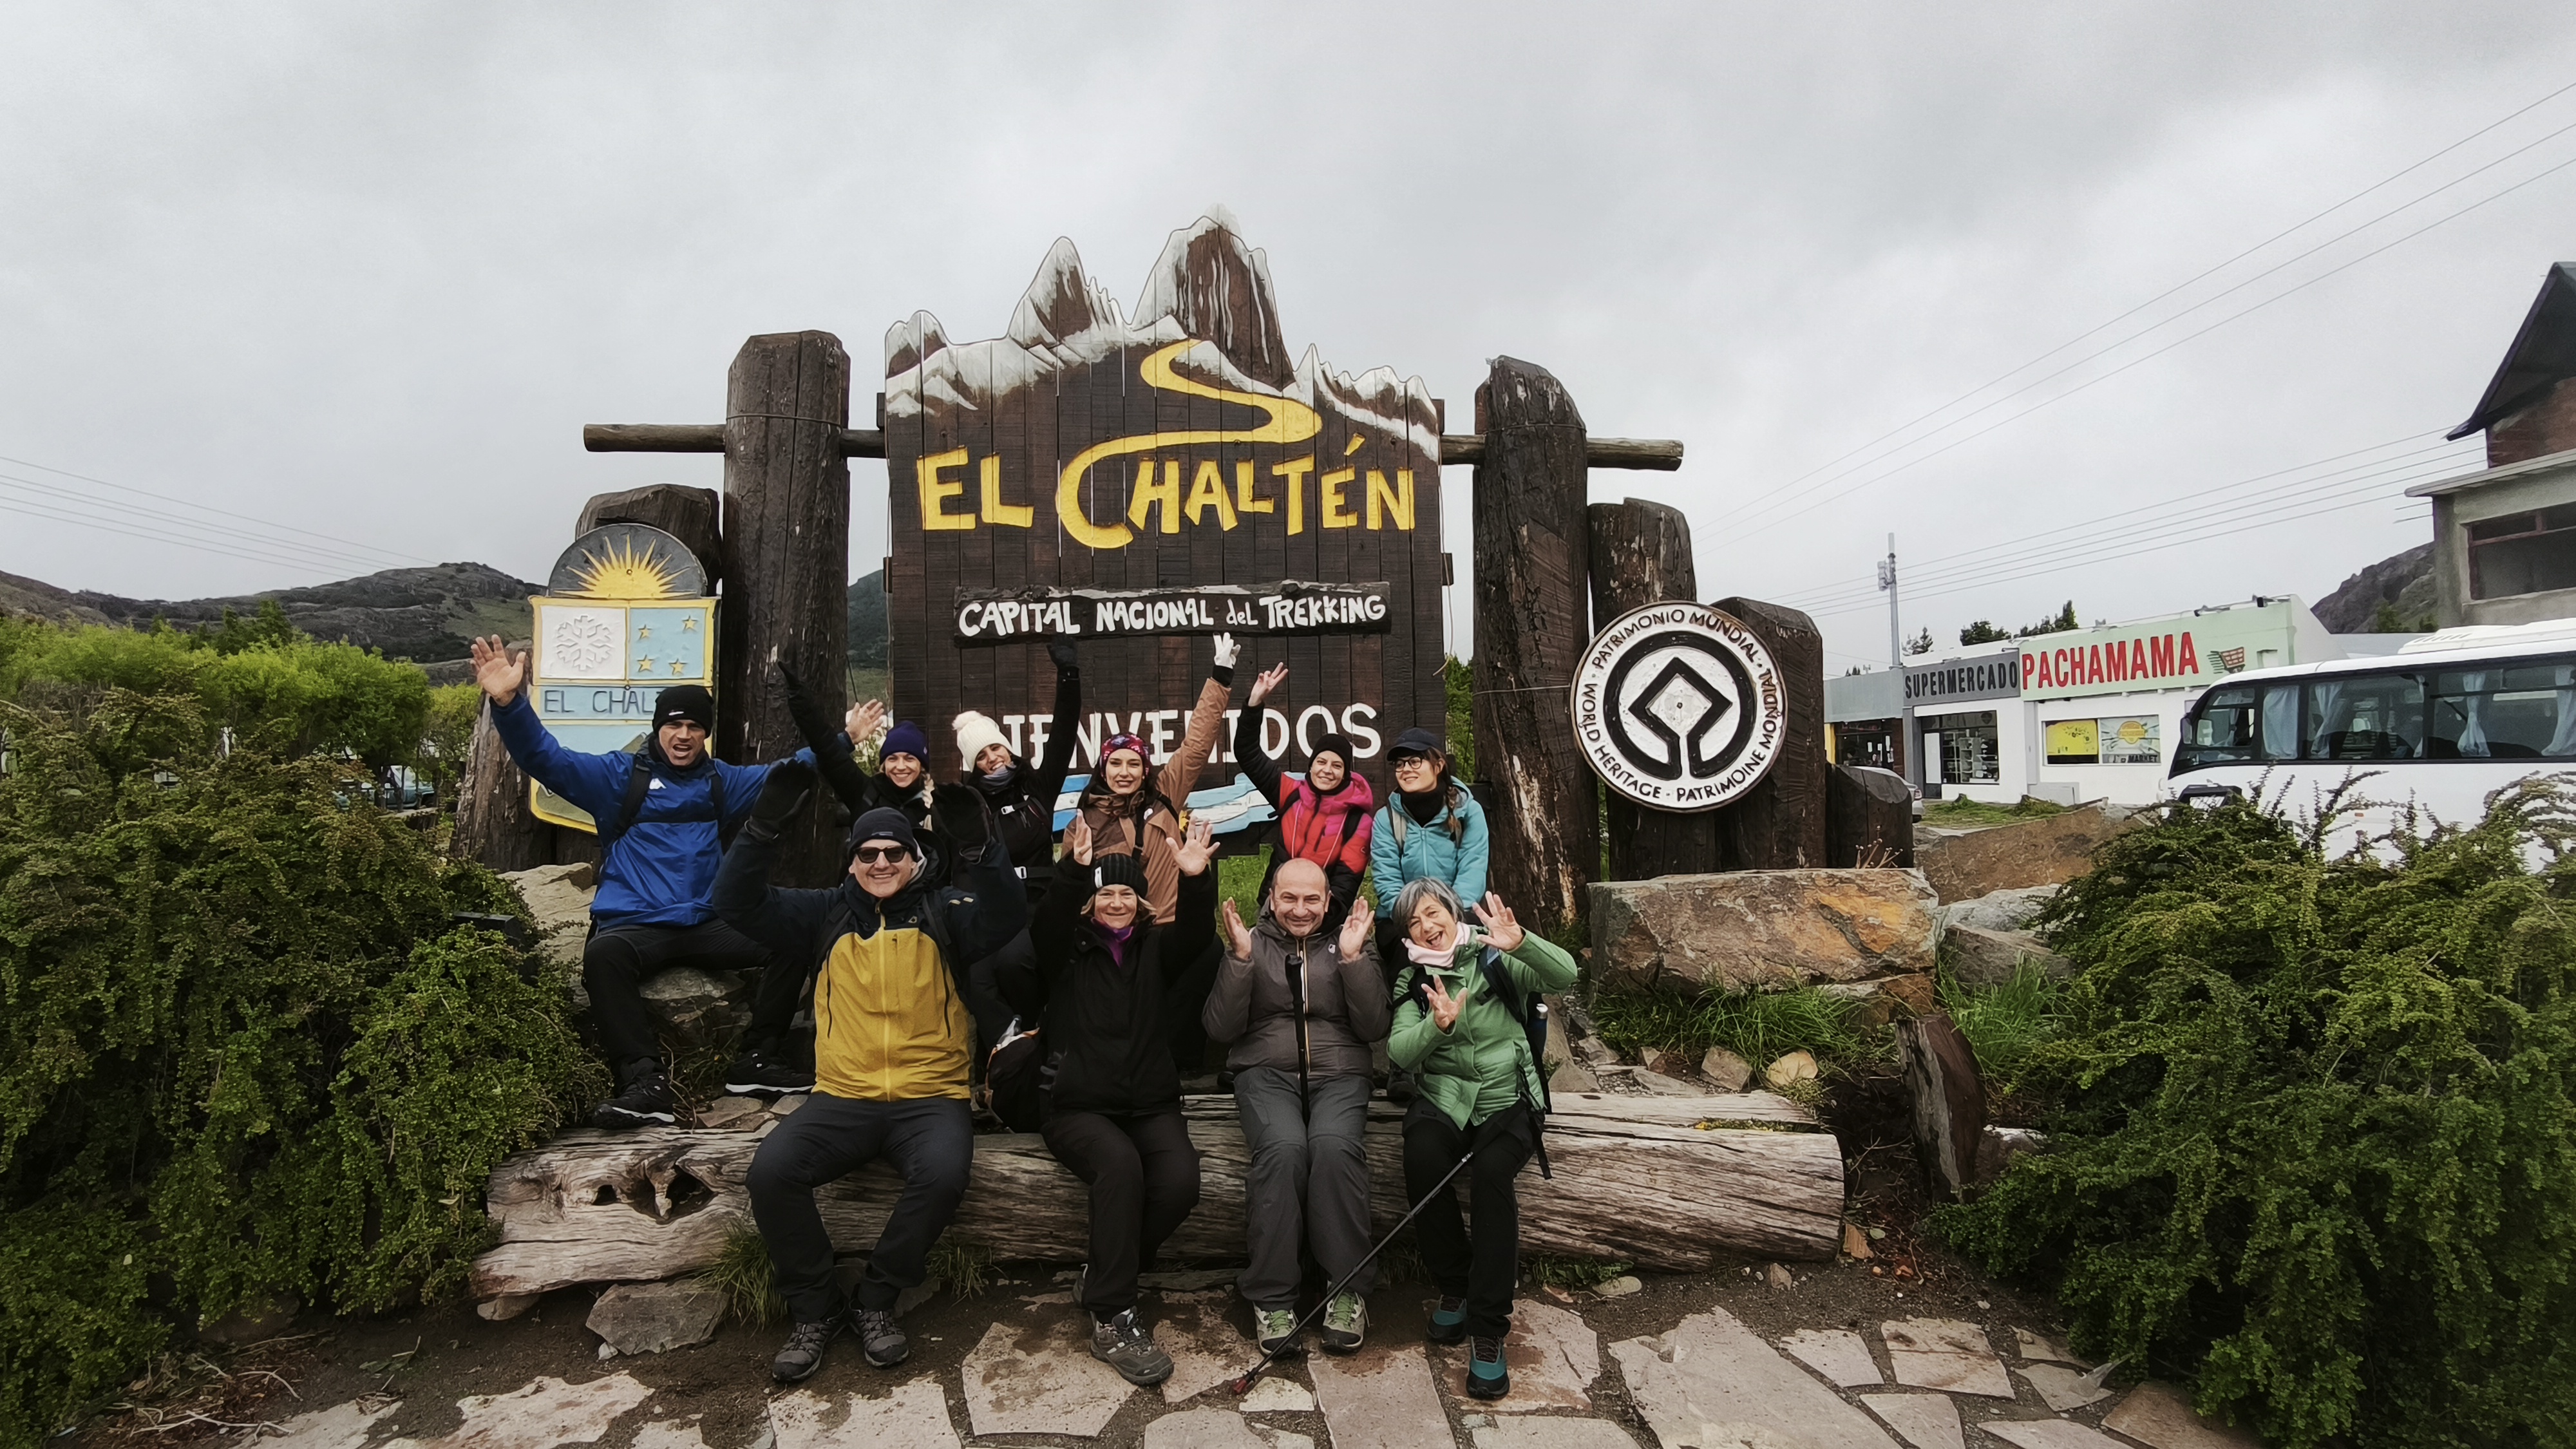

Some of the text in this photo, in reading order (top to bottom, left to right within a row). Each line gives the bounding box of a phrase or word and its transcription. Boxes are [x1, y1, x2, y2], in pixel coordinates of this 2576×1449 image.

[916, 430, 1416, 549] EL CHALTÉN
[959, 601, 1080, 636] CAPITAL
[1095, 598, 1214, 631] NACIONAL
[1259, 594, 1386, 629] TREKKING
[1592, 609, 1759, 670] PATRIMONIO MUNDIAL
[1904, 661, 2018, 699] SUPERMERCADO
[2022, 632, 2199, 690] PACHAMAMA
[545, 690, 662, 714] EL CHAL
[960, 703, 1381, 770] IENVEIDOS
[1581, 683, 1662, 799] WORLD HERITAGE
[1676, 668, 1781, 802] PATRIMOINE MONDIAL
